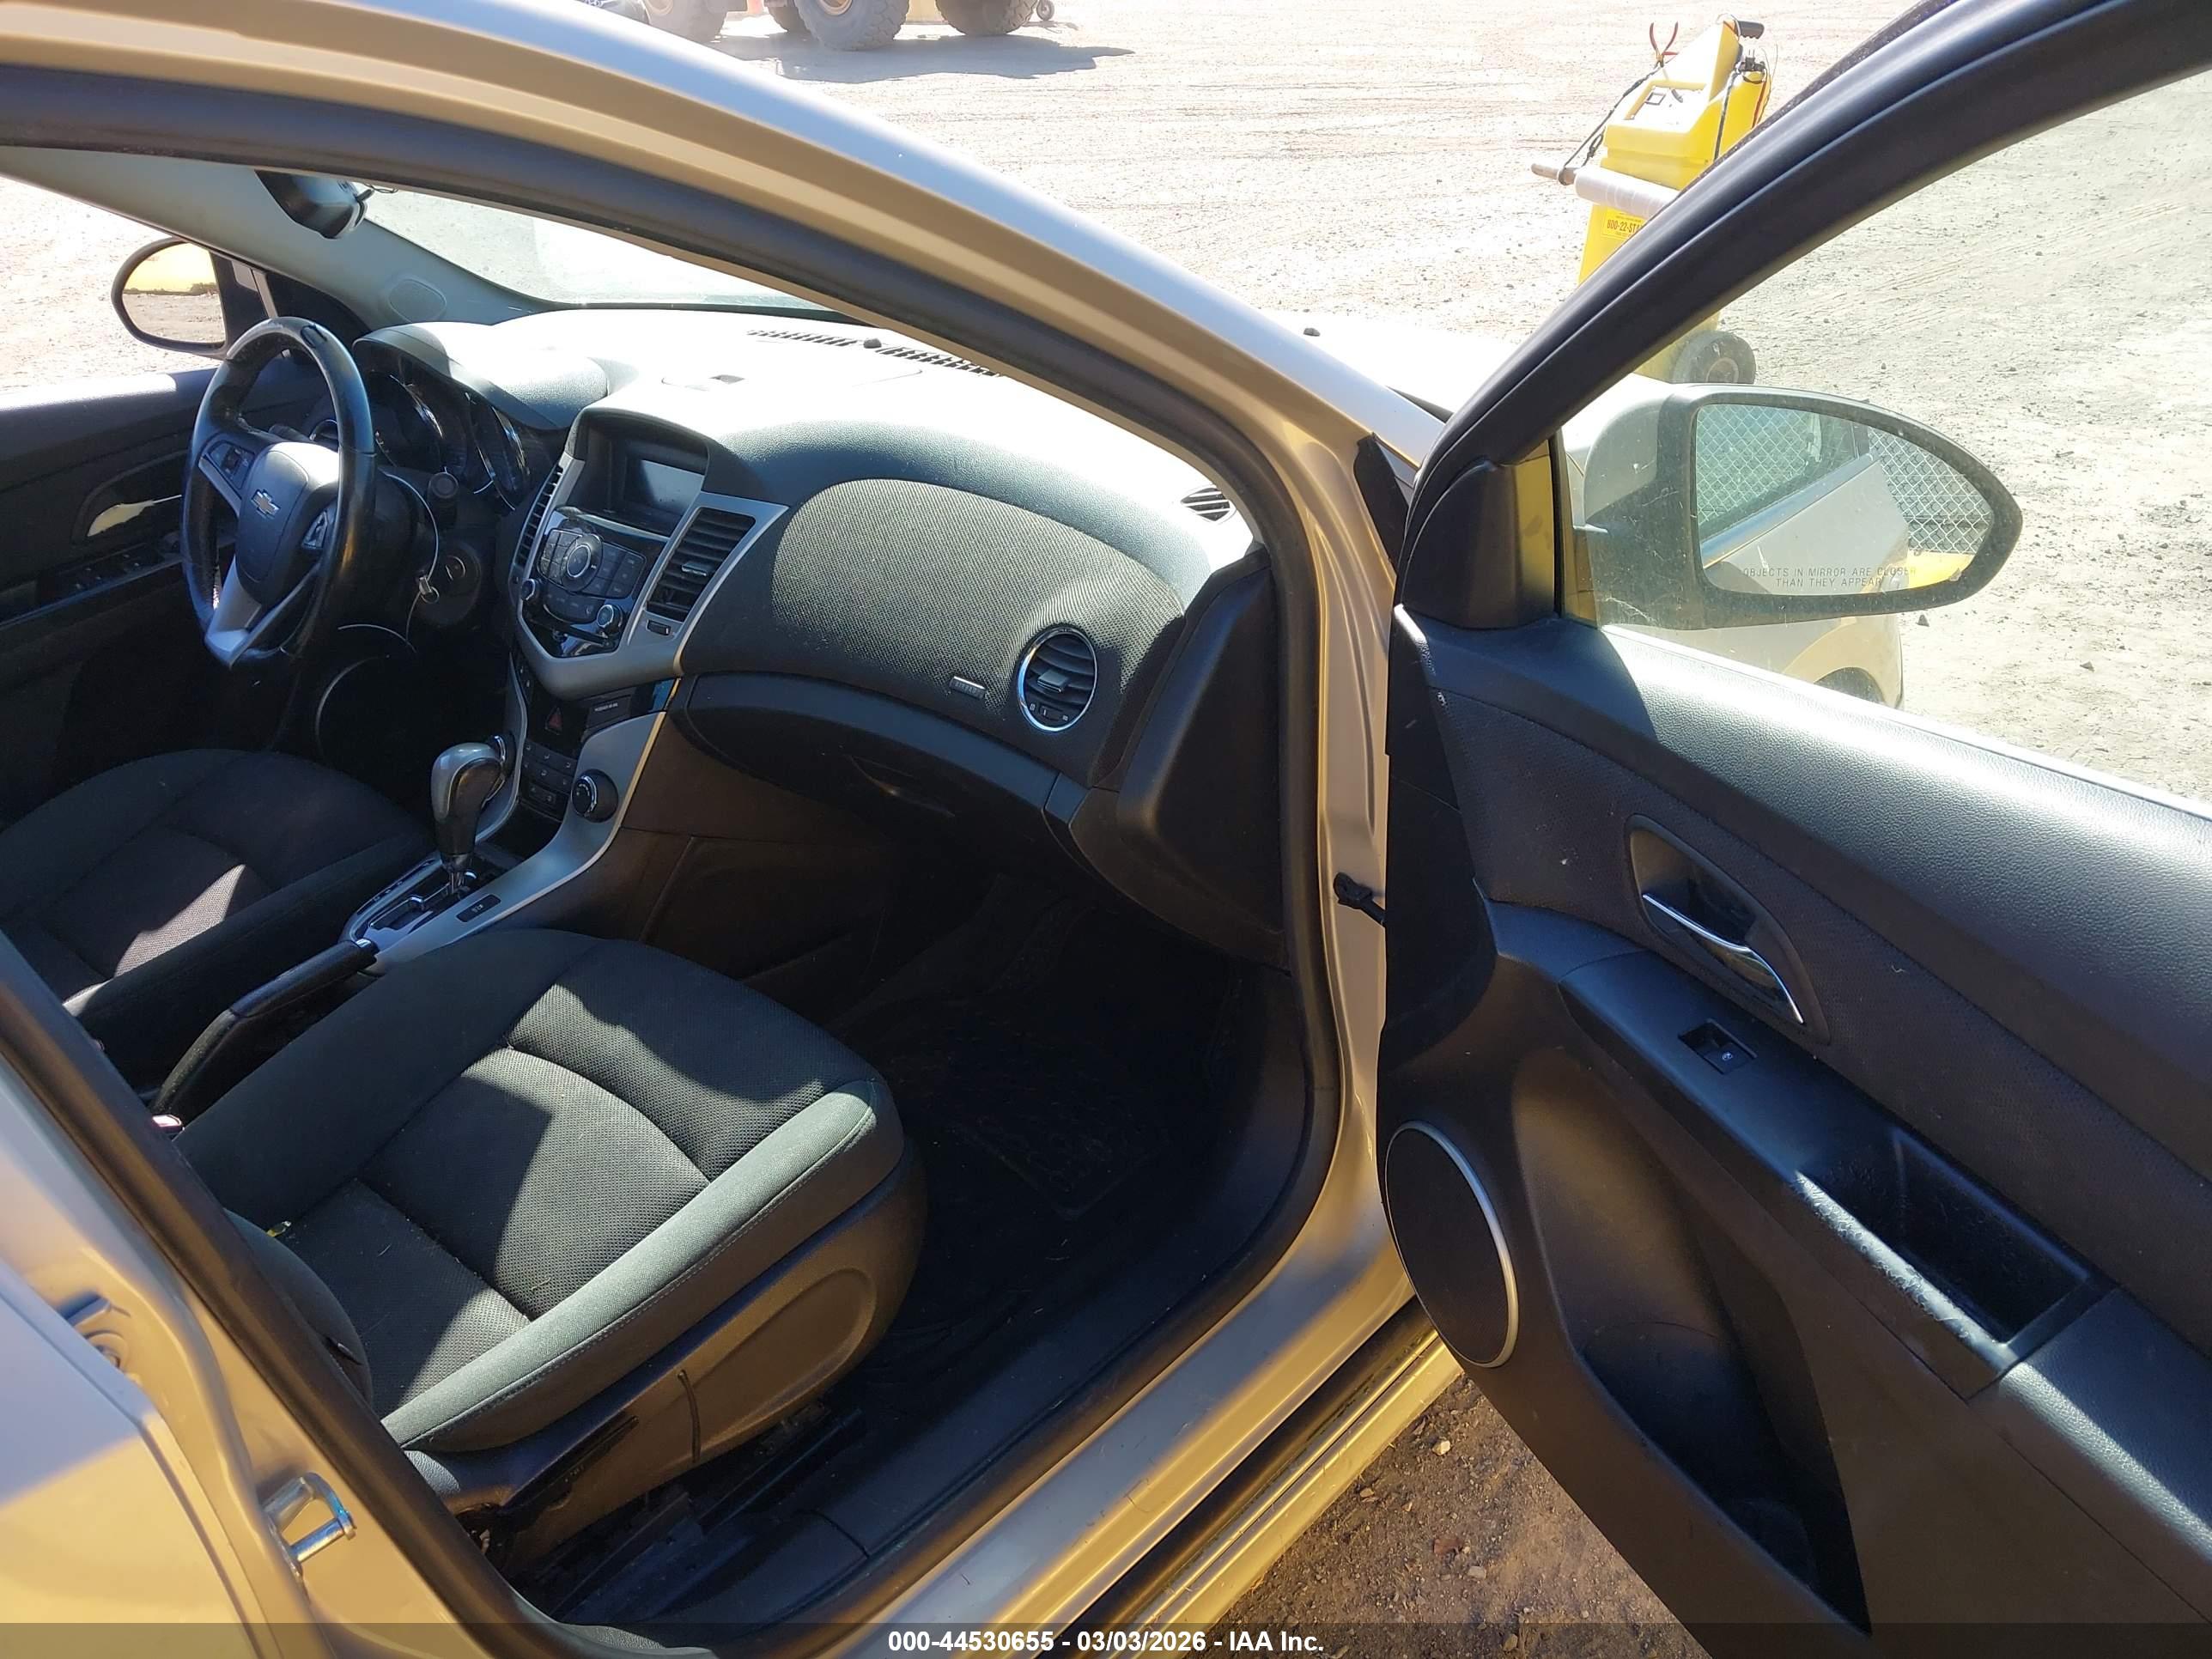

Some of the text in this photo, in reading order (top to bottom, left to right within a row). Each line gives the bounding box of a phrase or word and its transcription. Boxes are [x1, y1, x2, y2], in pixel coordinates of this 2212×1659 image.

[1743, 567, 1916, 577] OBJECTS IN MIRROR ARE CLOSER
[1776, 577, 1882, 587] THAN THEY APPEAR
